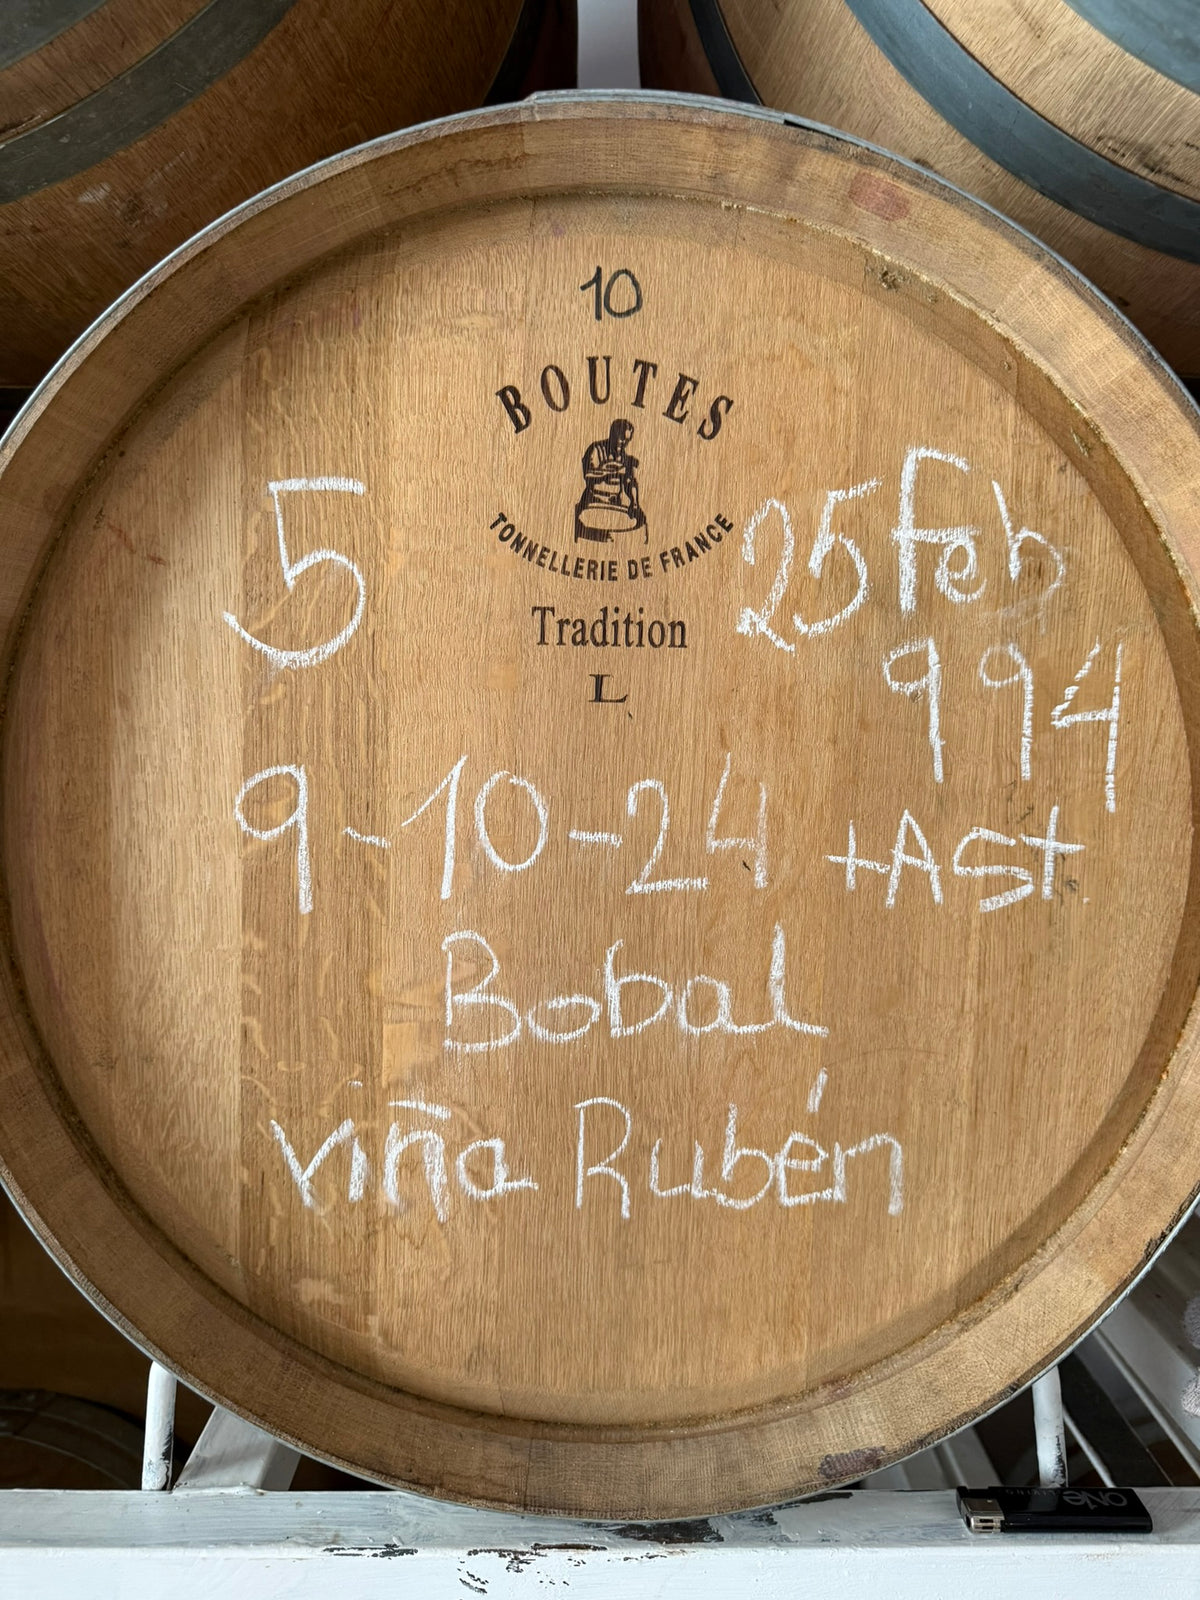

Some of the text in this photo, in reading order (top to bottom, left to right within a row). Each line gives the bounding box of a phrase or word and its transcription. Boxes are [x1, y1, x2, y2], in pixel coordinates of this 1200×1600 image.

[580, 266, 643, 321] 10
[495, 355, 735, 441] BOUTES
[223, 476, 367, 668] 5
[488, 511, 736, 582] TONNELLERIE DE FRANCE
[736, 475, 884, 656] 25
[531, 605, 688, 649] Tradition
[588, 673, 629, 703] L
[882, 637, 1124, 814] 994
[441, 921, 829, 1053] Bobal
[574, 1067, 904, 1218] Rubén
